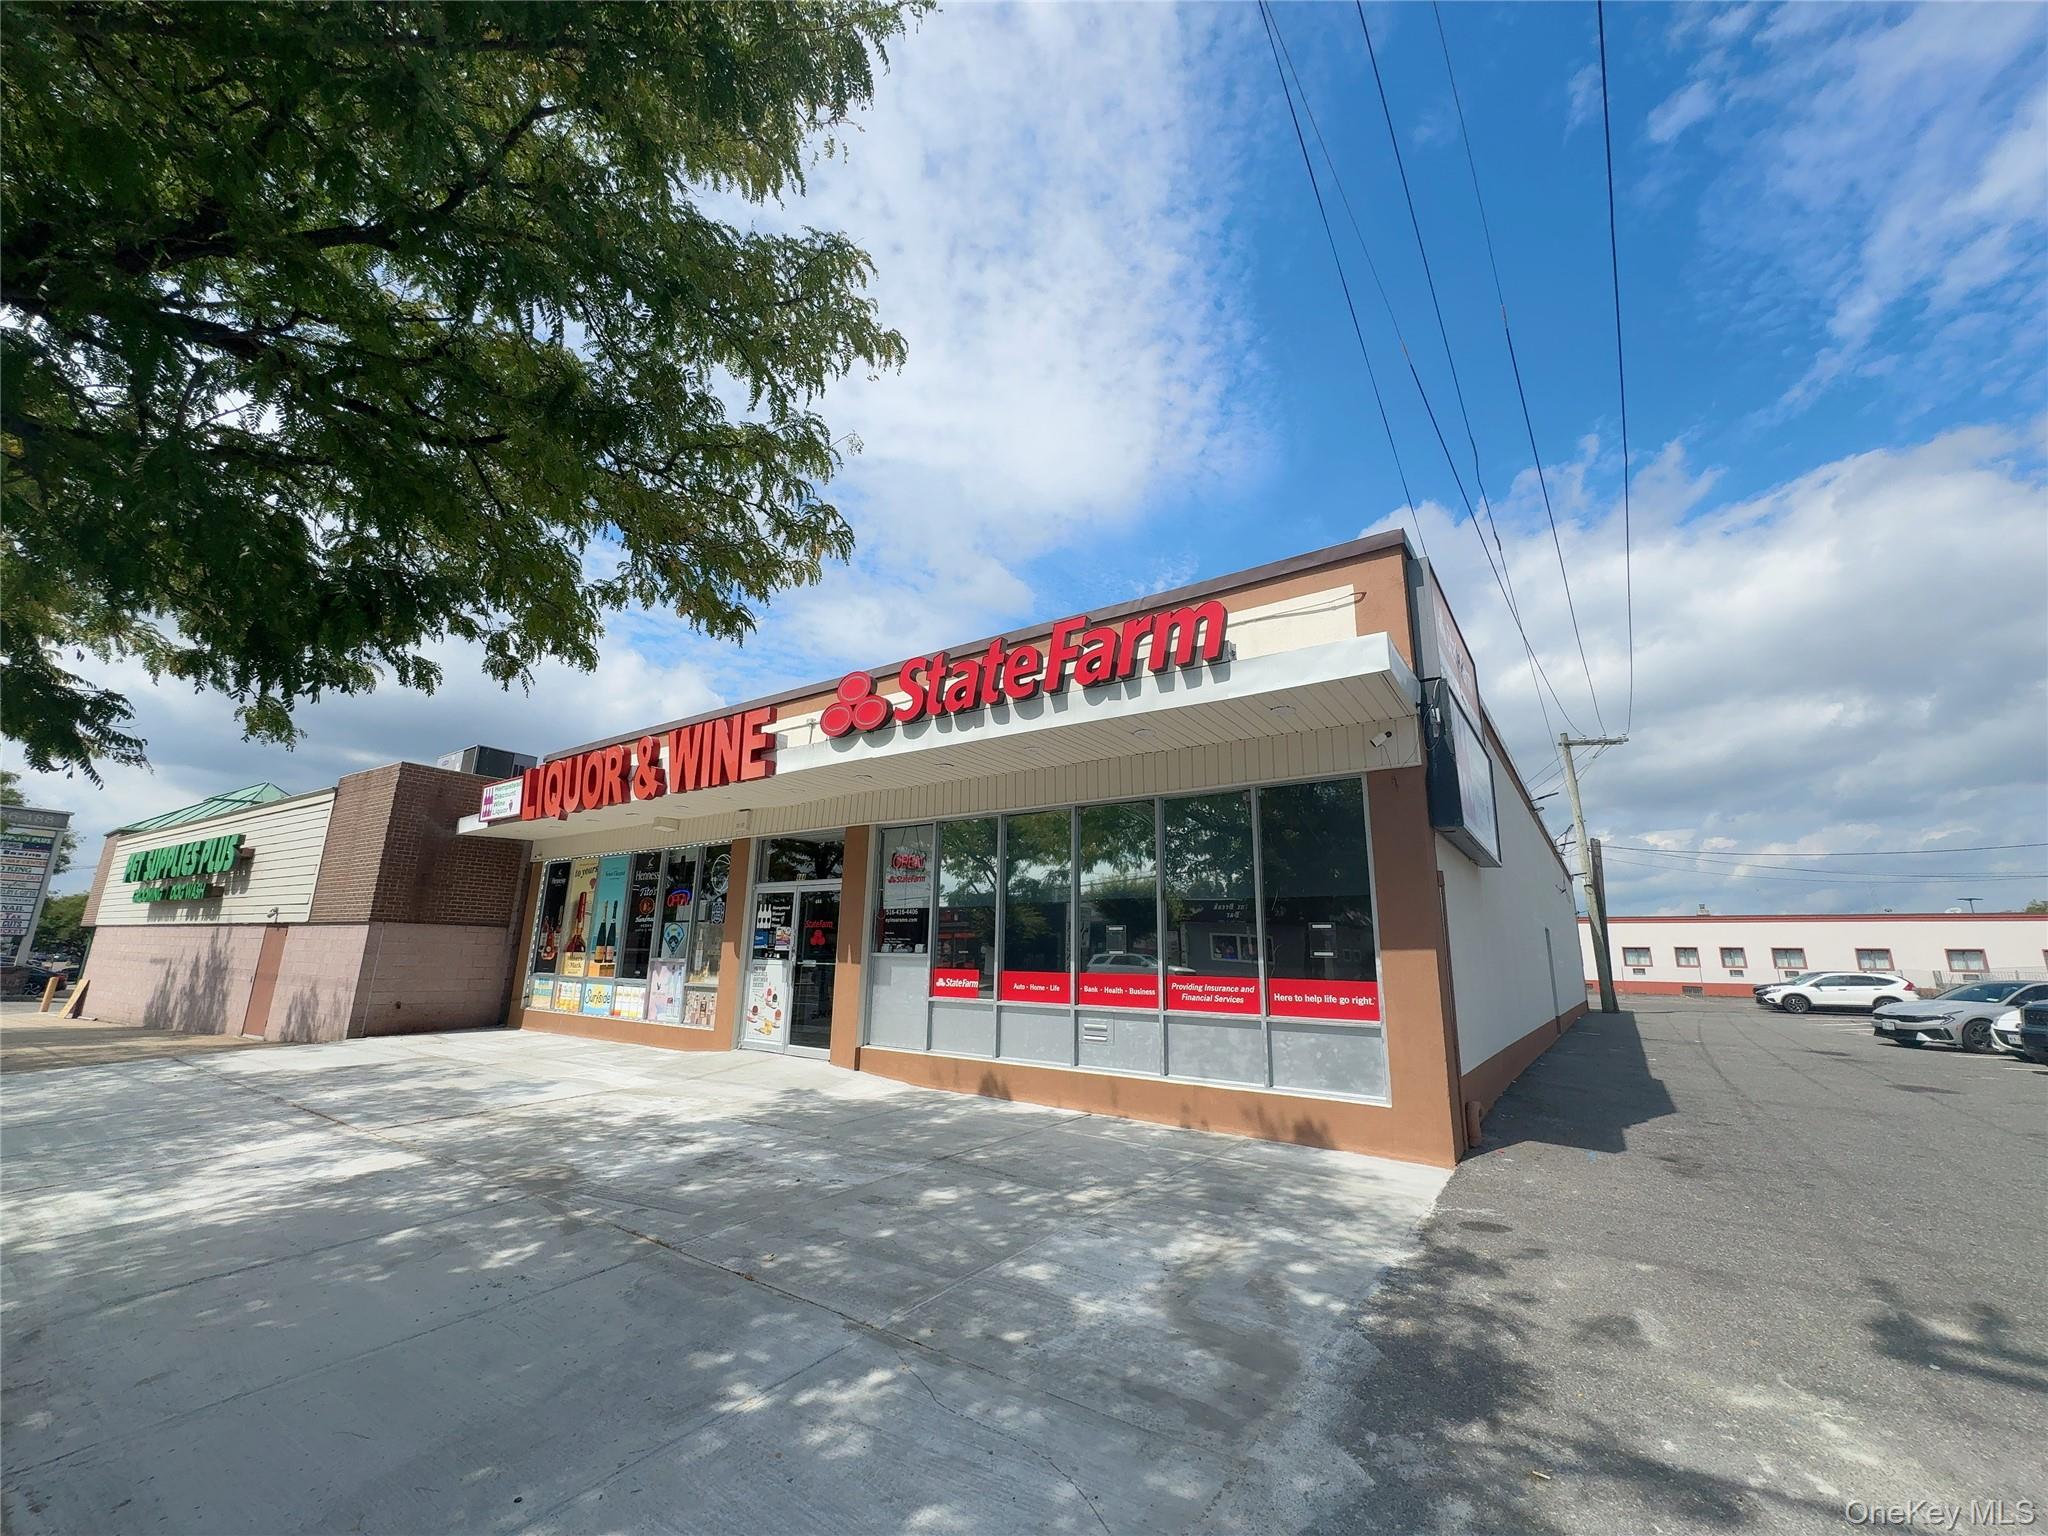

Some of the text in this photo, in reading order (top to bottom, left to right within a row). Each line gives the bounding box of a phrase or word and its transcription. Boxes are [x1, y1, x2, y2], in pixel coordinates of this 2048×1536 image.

[521, 706, 777, 821] LIQUOR & WINE
[123, 834, 242, 883] PET SUPPLIES PLUS
[635, 870, 661, 881] Henness
[170, 882, 186, 900] DOG
[185, 880, 207, 900] WASH
[1029, 983, 1046, 991] Home
[1049, 984, 1060, 992] Life
[1083, 985, 1156, 996] Bank Health Business
[1171, 982, 1256, 994] Providing Insurance and
[1181, 993, 1245, 1004] Financial Services
[1273, 992, 1293, 1002] Here
[1294, 993, 1303, 1002] to
[1304, 993, 1323, 1004] help
[1324, 994, 1337, 1003] life
[1340, 997, 1350, 1005] go
